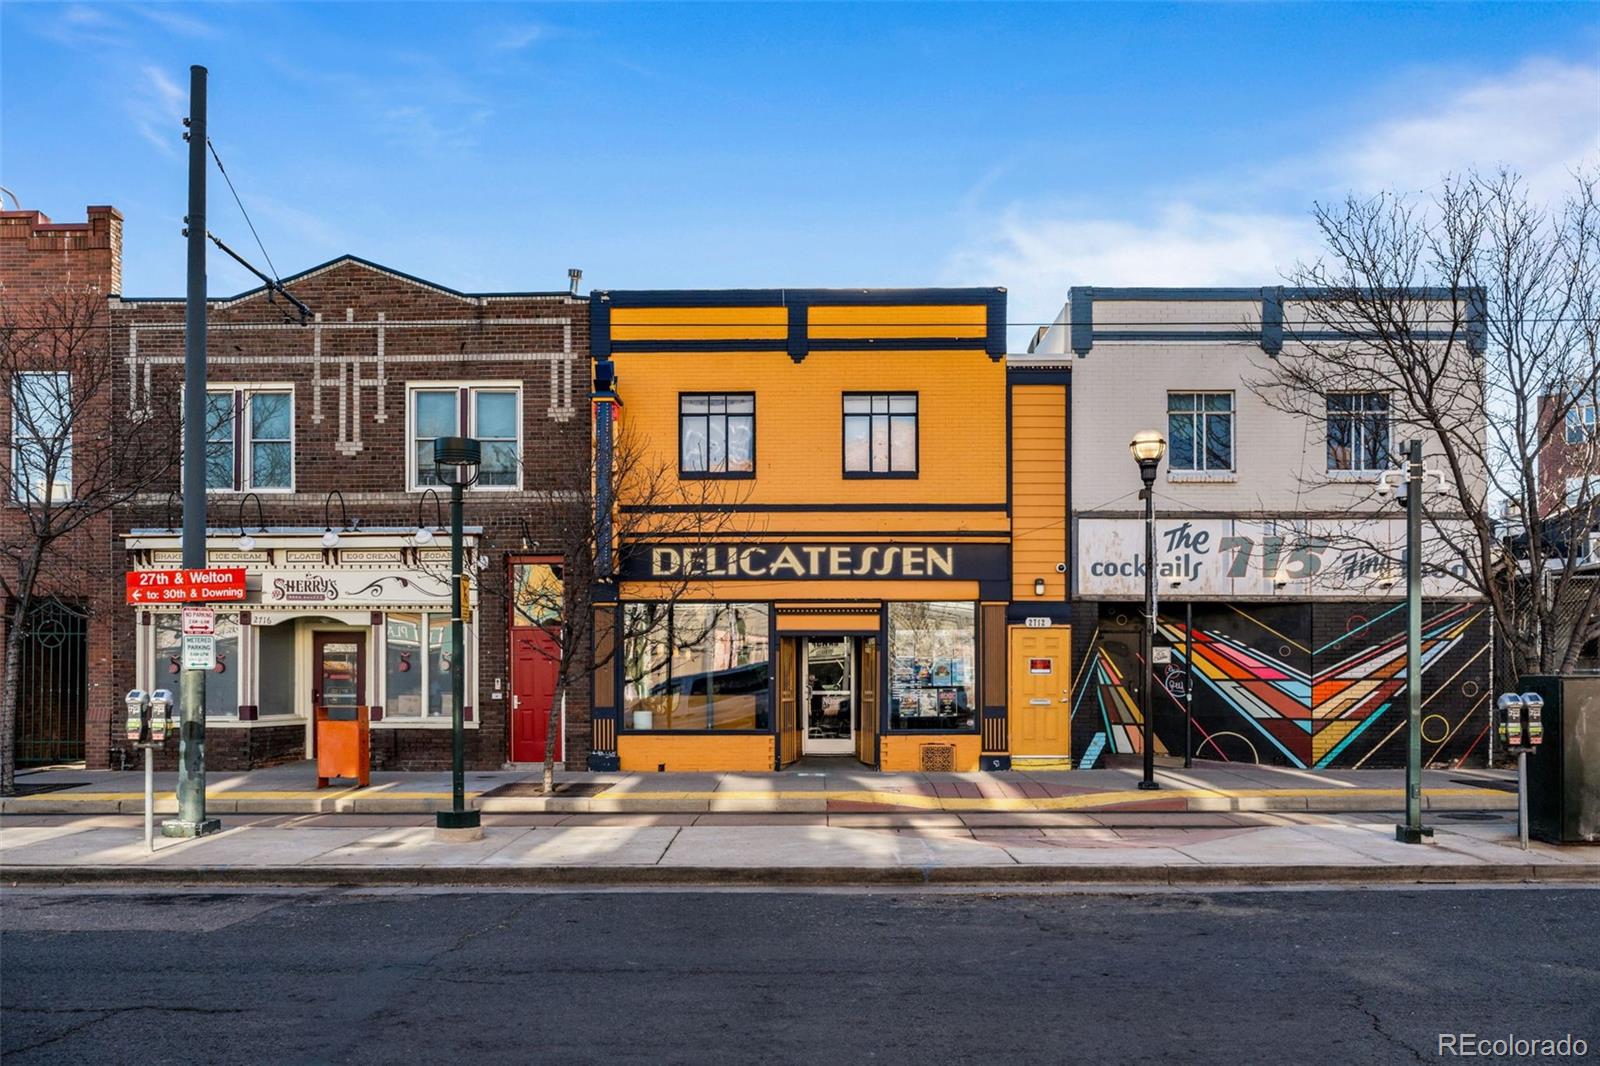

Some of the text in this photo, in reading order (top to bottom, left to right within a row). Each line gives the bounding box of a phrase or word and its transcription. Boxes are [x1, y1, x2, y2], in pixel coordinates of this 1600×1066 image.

[1163, 521, 1210, 555] The
[652, 546, 952, 576] DELICATESSEN
[1091, 553, 1202, 581] cockails
[1218, 536, 1331, 579] 715
[140, 571, 233, 585] 27th & Welton
[273, 575, 339, 600] SHERRY'S
[146, 587, 243, 599] to: 30th & Downing
[253, 616, 272, 624] 2716
